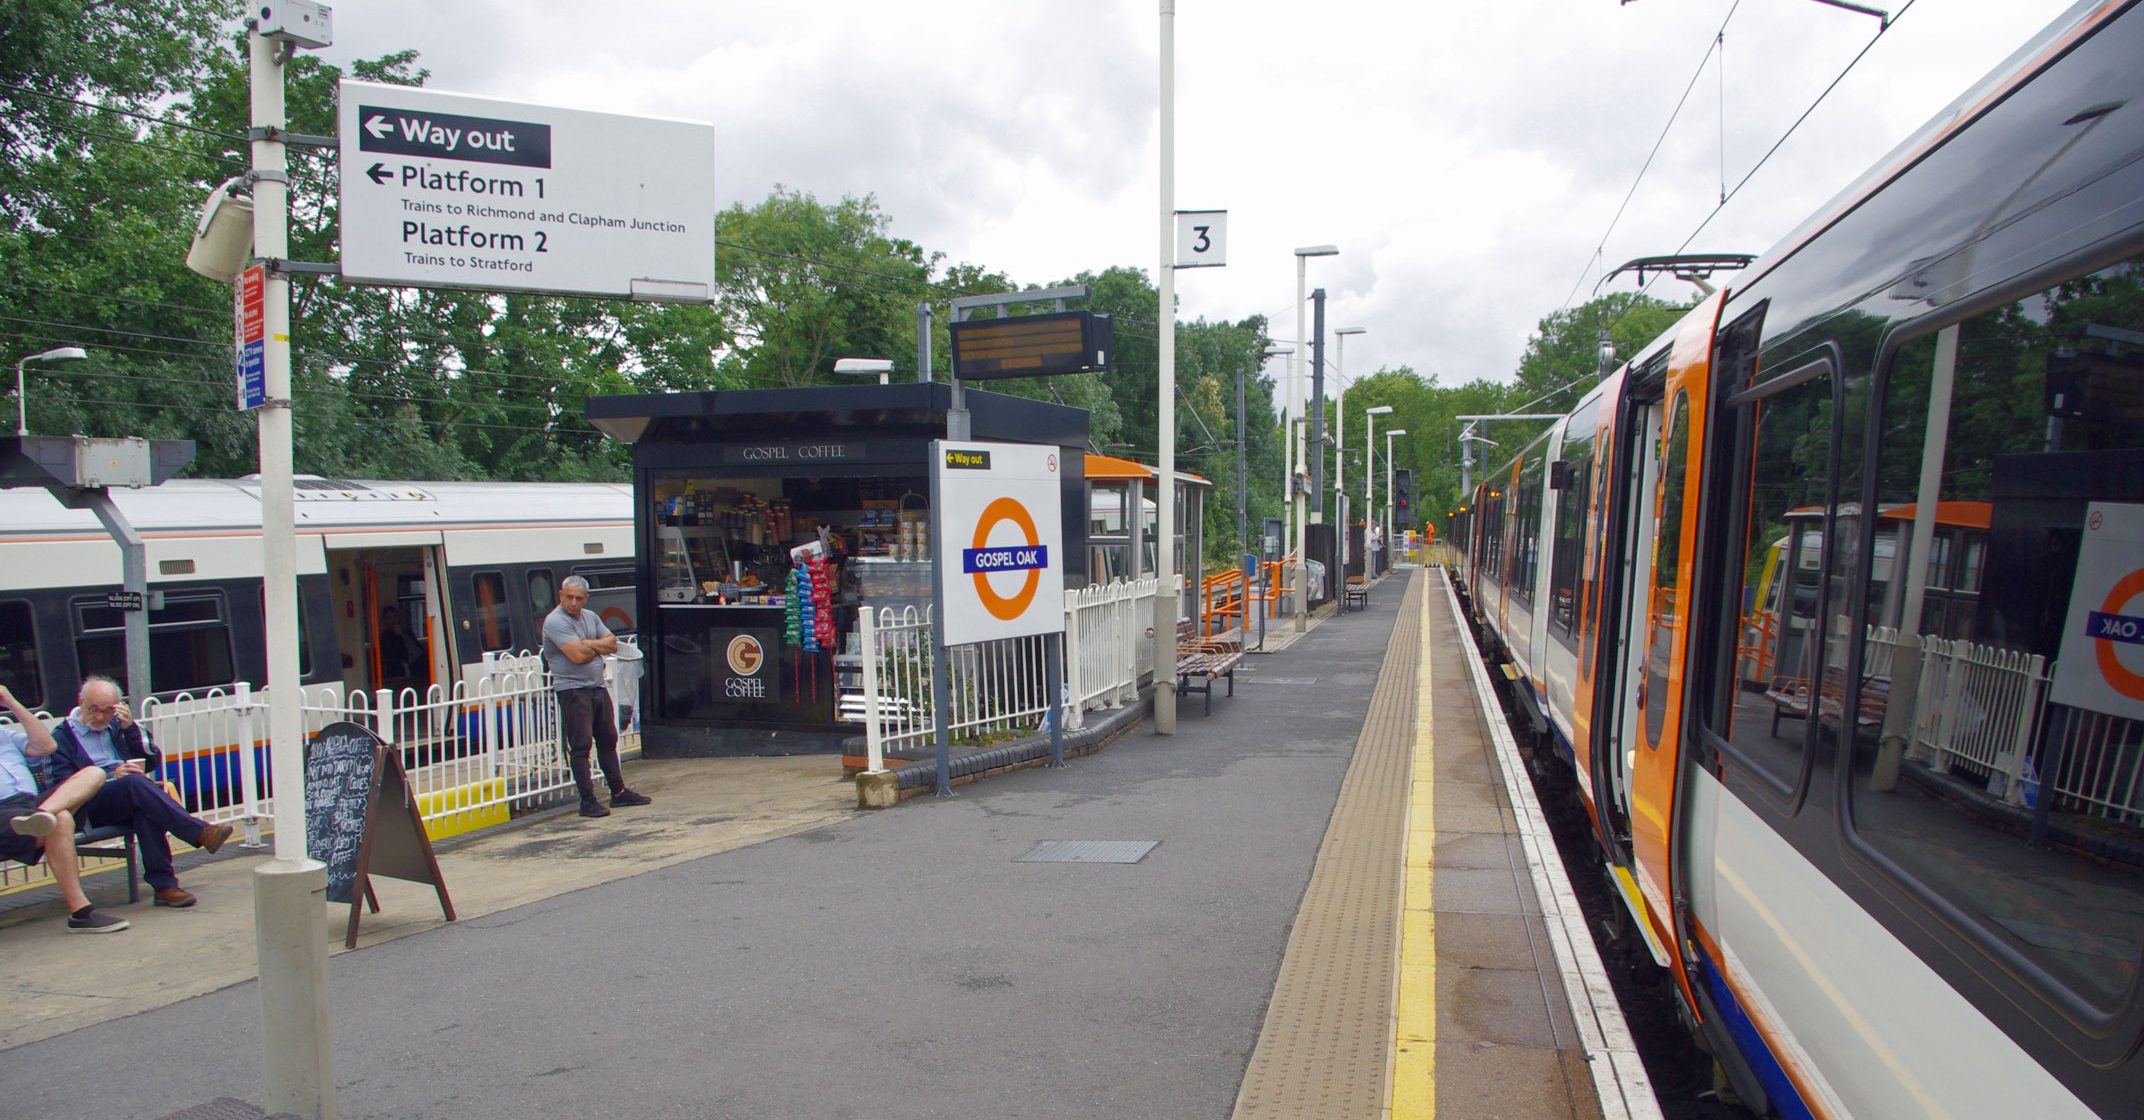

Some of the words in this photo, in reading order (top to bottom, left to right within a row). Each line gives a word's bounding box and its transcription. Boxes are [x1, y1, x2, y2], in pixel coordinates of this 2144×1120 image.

[400, 117, 461, 151] Way
[467, 130, 515, 151] out
[402, 165, 523, 197] Platform
[535, 178, 544, 199] 1
[401, 198, 442, 214] Trains
[447, 203, 462, 215] to
[467, 205, 535, 221] Richmond
[540, 211, 564, 223] and
[568, 213, 626, 229] Clapham
[630, 218, 686, 233] Junction
[402, 221, 524, 251] Platform
[534, 231, 548, 252] 2
[1192, 226, 1210, 253] 3
[404, 252, 445, 266] Trains
[450, 255, 465, 267] to
[470, 256, 533, 272] Stratford
[743, 446, 789, 460] GOSPEL
[798, 445, 846, 458] COFFEE
[954, 452, 970, 466] Way
[970, 454, 983, 464] out
[975, 552, 1015, 568] GOSPEL
[1016, 550, 1038, 565] OAK
[725, 677, 765, 689] GOSPEL
[725, 686, 766, 698] COFFEE
